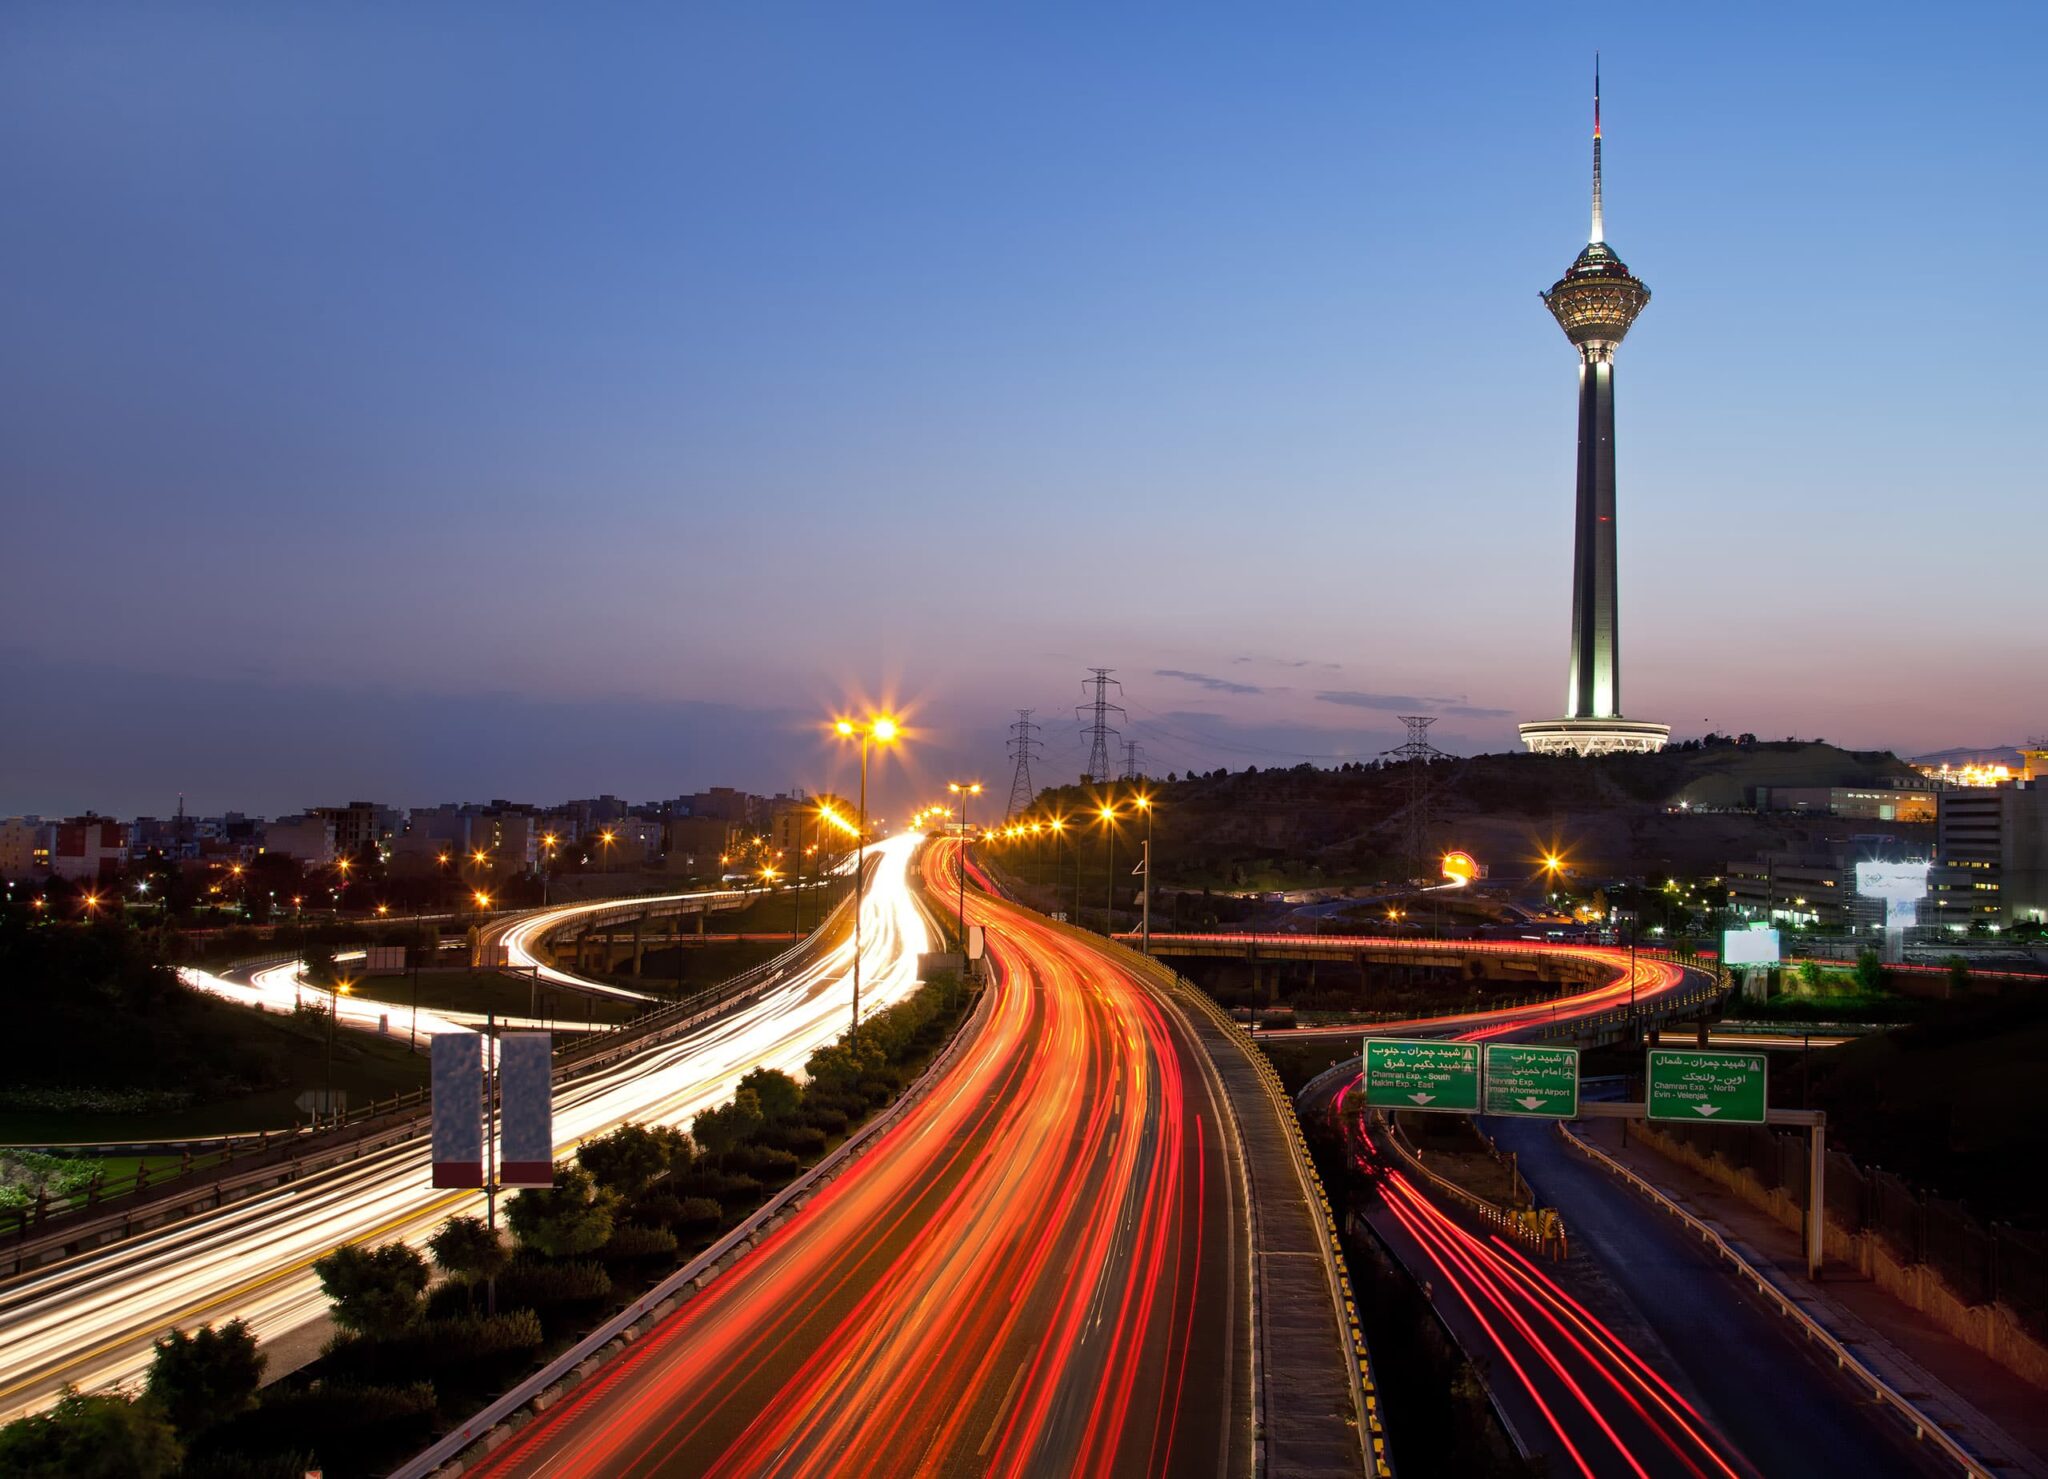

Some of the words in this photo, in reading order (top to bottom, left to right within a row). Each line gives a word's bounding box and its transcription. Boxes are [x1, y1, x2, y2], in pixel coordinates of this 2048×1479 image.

[1372, 1047, 1399, 1056] جنوب
[1408, 1048, 1435, 1058] چمران
[1437, 1048, 1460, 1057] شهید
[1511, 1053, 1536, 1064] نواب
[1538, 1053, 1561, 1063] شهید
[1656, 1056, 1682, 1065] شمال
[1384, 1059, 1405, 1069] شرق
[1413, 1061, 1435, 1071] حکیم
[1691, 1058, 1720, 1070] چمران
[1722, 1059, 1746, 1068] شهید
[1542, 1068, 1561, 1078] امام
[1724, 1075, 1745, 1084] اوین
[1677, 1092, 1708, 1100] Velenjak
